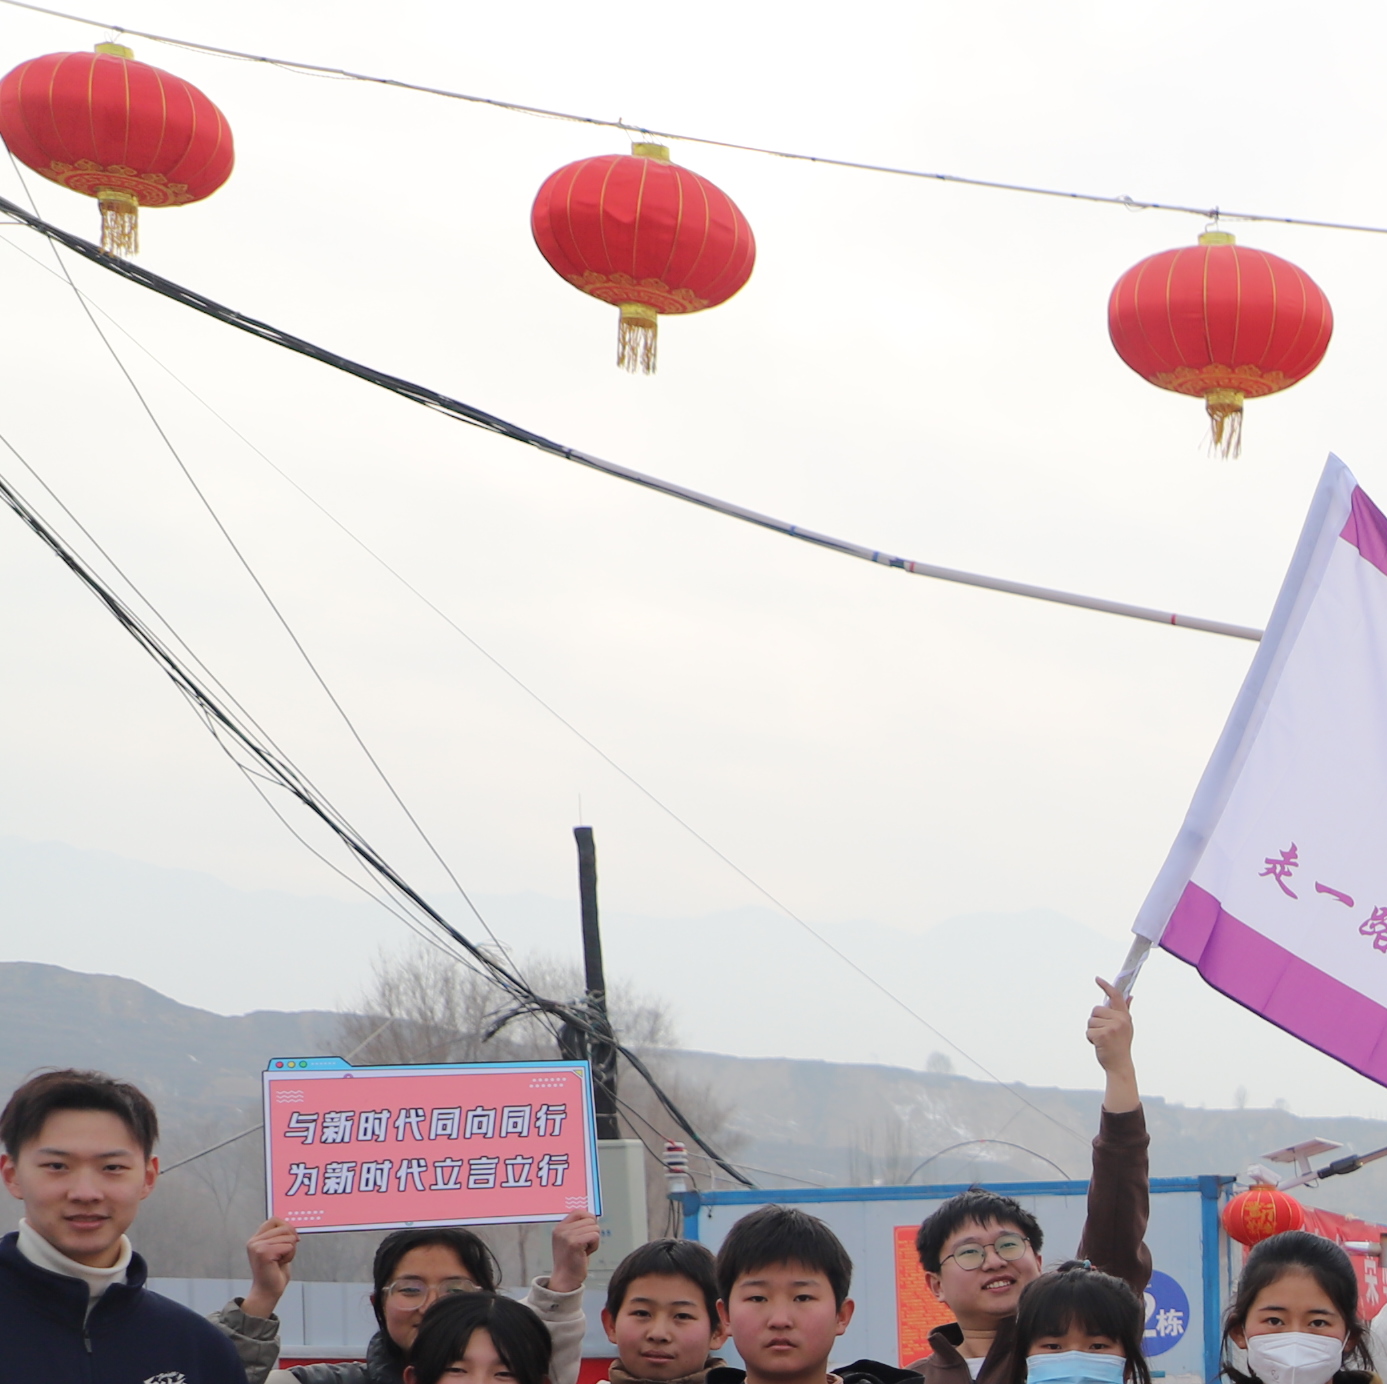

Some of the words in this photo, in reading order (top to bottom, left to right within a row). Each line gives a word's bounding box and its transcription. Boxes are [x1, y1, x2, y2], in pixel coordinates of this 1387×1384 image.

[284, 1103, 568, 1147] 与新时代同向同行
[285, 1153, 570, 1197] 为新时代立言立行
